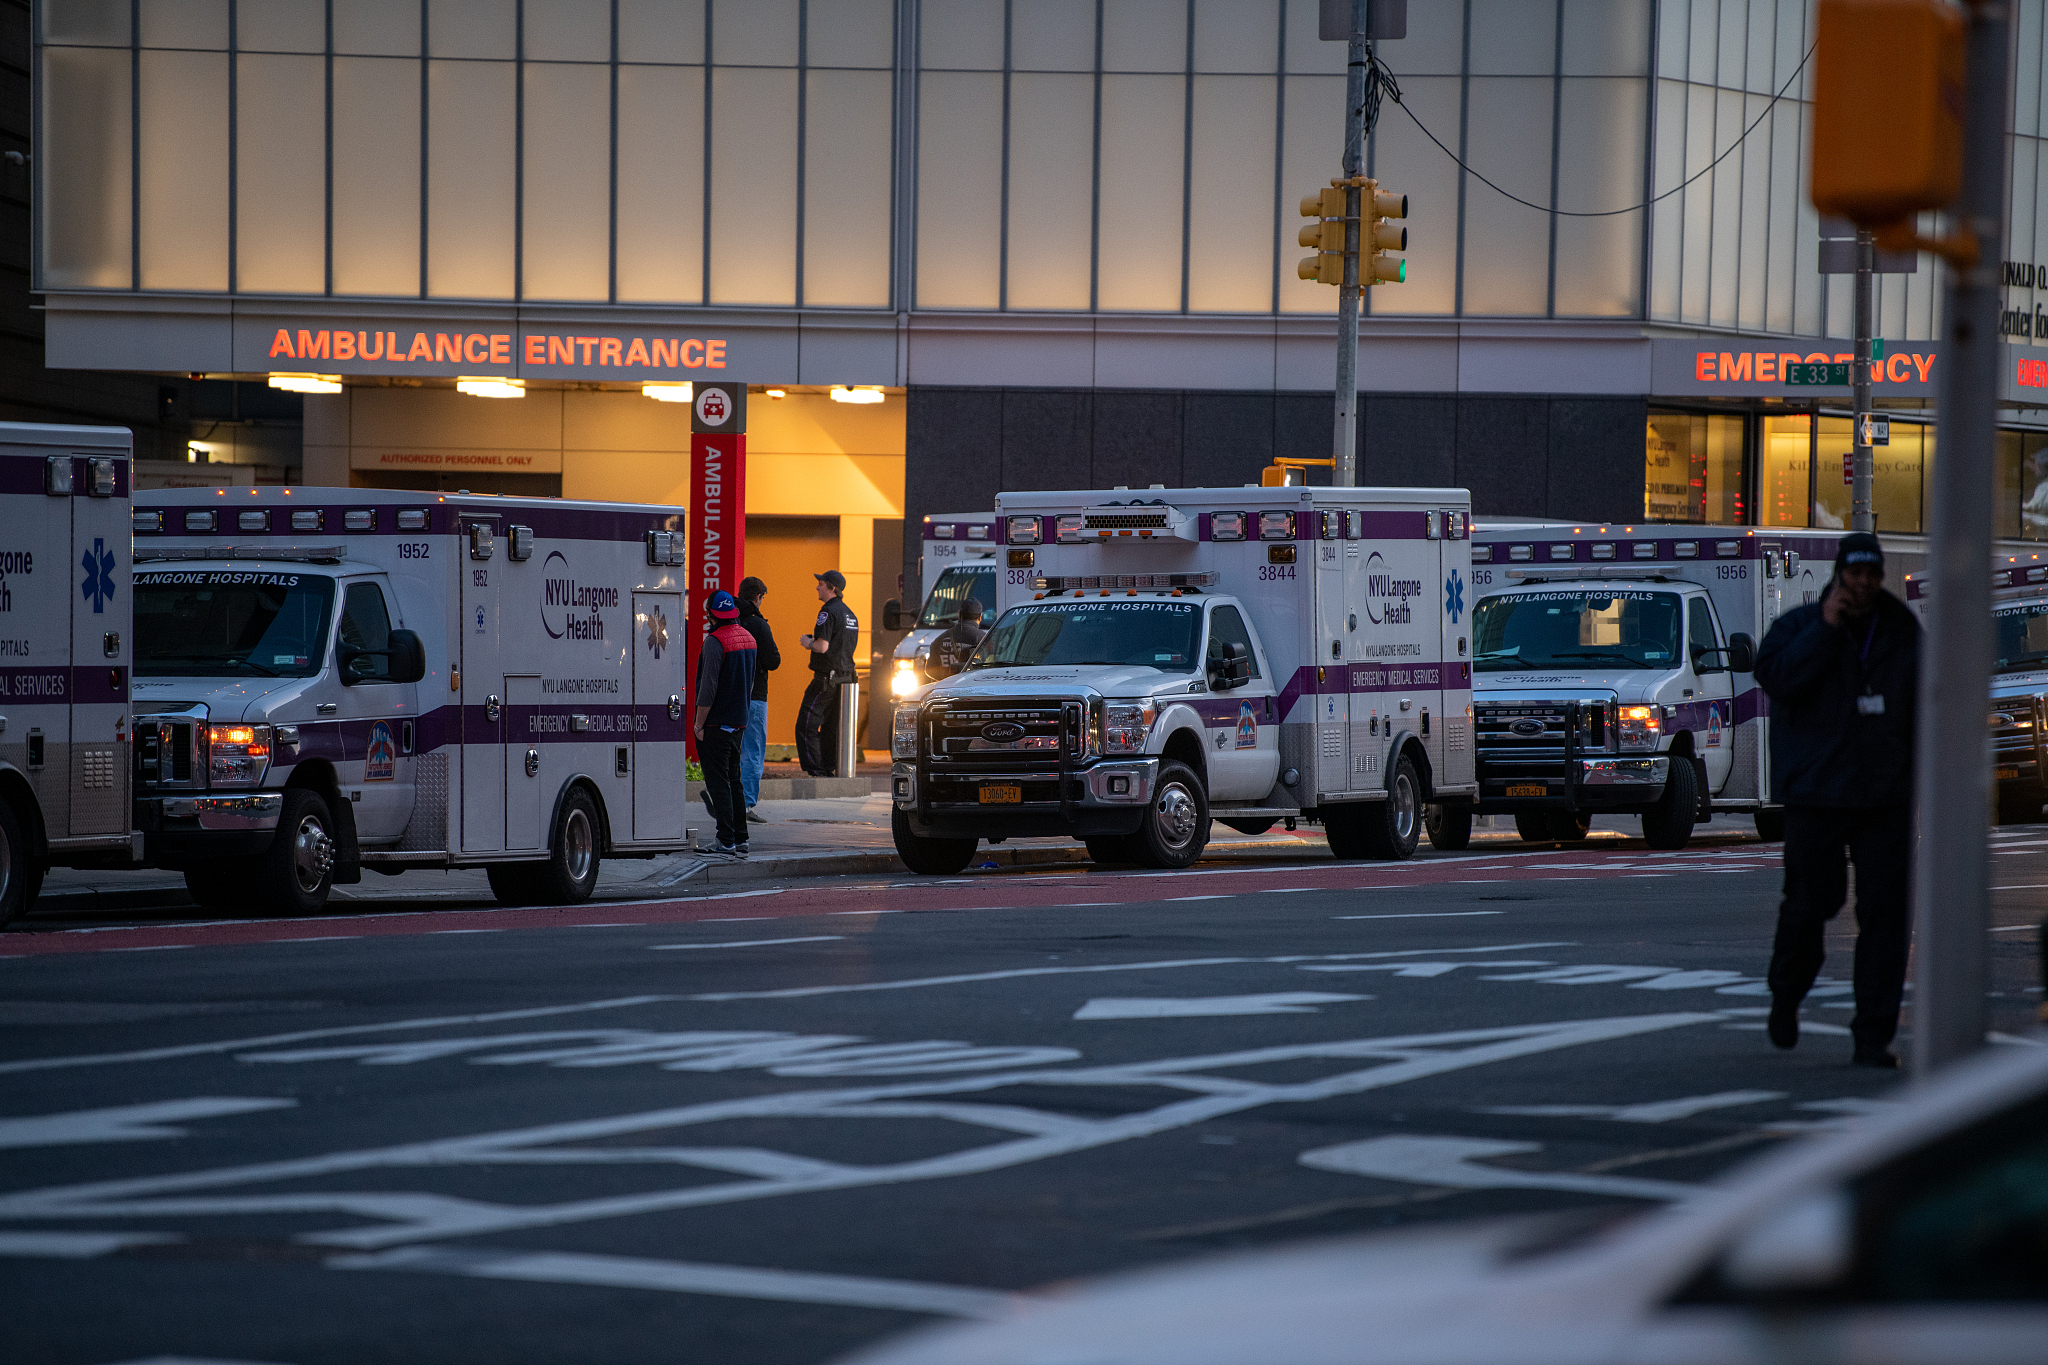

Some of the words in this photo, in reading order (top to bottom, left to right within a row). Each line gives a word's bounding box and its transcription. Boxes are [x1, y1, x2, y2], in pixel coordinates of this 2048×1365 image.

[2001, 261, 2036, 288] ONALD
[2000, 300, 2032, 338] enter
[269, 329, 511, 364] AMBULANCE
[525, 335, 727, 369] ENTRANCE
[1791, 366, 1800, 383] E
[1808, 366, 1828, 384] 33
[1836, 366, 1845, 376] ST
[2017, 358, 2048, 388] EMER
[1877, 423, 1888, 436] WAY
[380, 454, 443, 465] AUTHORIZED
[445, 455, 503, 466] PERSONNEL
[506, 456, 533, 467] ONLY
[703, 446, 722, 590] AMBULANCE
[397, 543, 430, 559] 1952
[933, 545, 957, 557] 1954
[1321, 547, 1336, 562] 3844
[132, 573, 206, 585] LANGONE
[208, 573, 300, 587] HOSPITALS
[472, 569, 488, 587] 1952
[1258, 565, 1297, 581] 3844
[1716, 565, 1747, 580] 1956
[546, 579, 570, 606] NYU
[571, 580, 619, 613] Langone
[1368, 575, 1386, 598] NYU
[1387, 575, 1422, 602] Langone
[1500, 594, 1525, 605] NYU
[1526, 592, 1583, 603] LANGONE
[1585, 591, 1654, 602] HOSPITALS
[1012, 606, 1041, 616] NYU
[1042, 603, 1105, 614] LANGONE
[1111, 603, 1192, 613] HOSPITALS
[1384, 602, 1411, 624] Health
[566, 614, 604, 640] Health
[0, 640, 29, 657] PITALS
[1365, 644, 1376, 657] NYU
[1376, 644, 1396, 657] LANGONE
[1397, 643, 1421, 656] HOSPITALS
[15, 674, 65, 696] SERVICES
[542, 679, 555, 694] NYU
[556, 679, 584, 694] LANGONE
[585, 679, 619, 694] HOSPITALS
[1353, 671, 1387, 687] EMERGENCY
[1388, 670, 1412, 686] MEDICAL
[1413, 669, 1439, 685] SERVICES
[529, 715, 569, 733] EMERGENCY
[990, 727, 1014, 737] Ford
